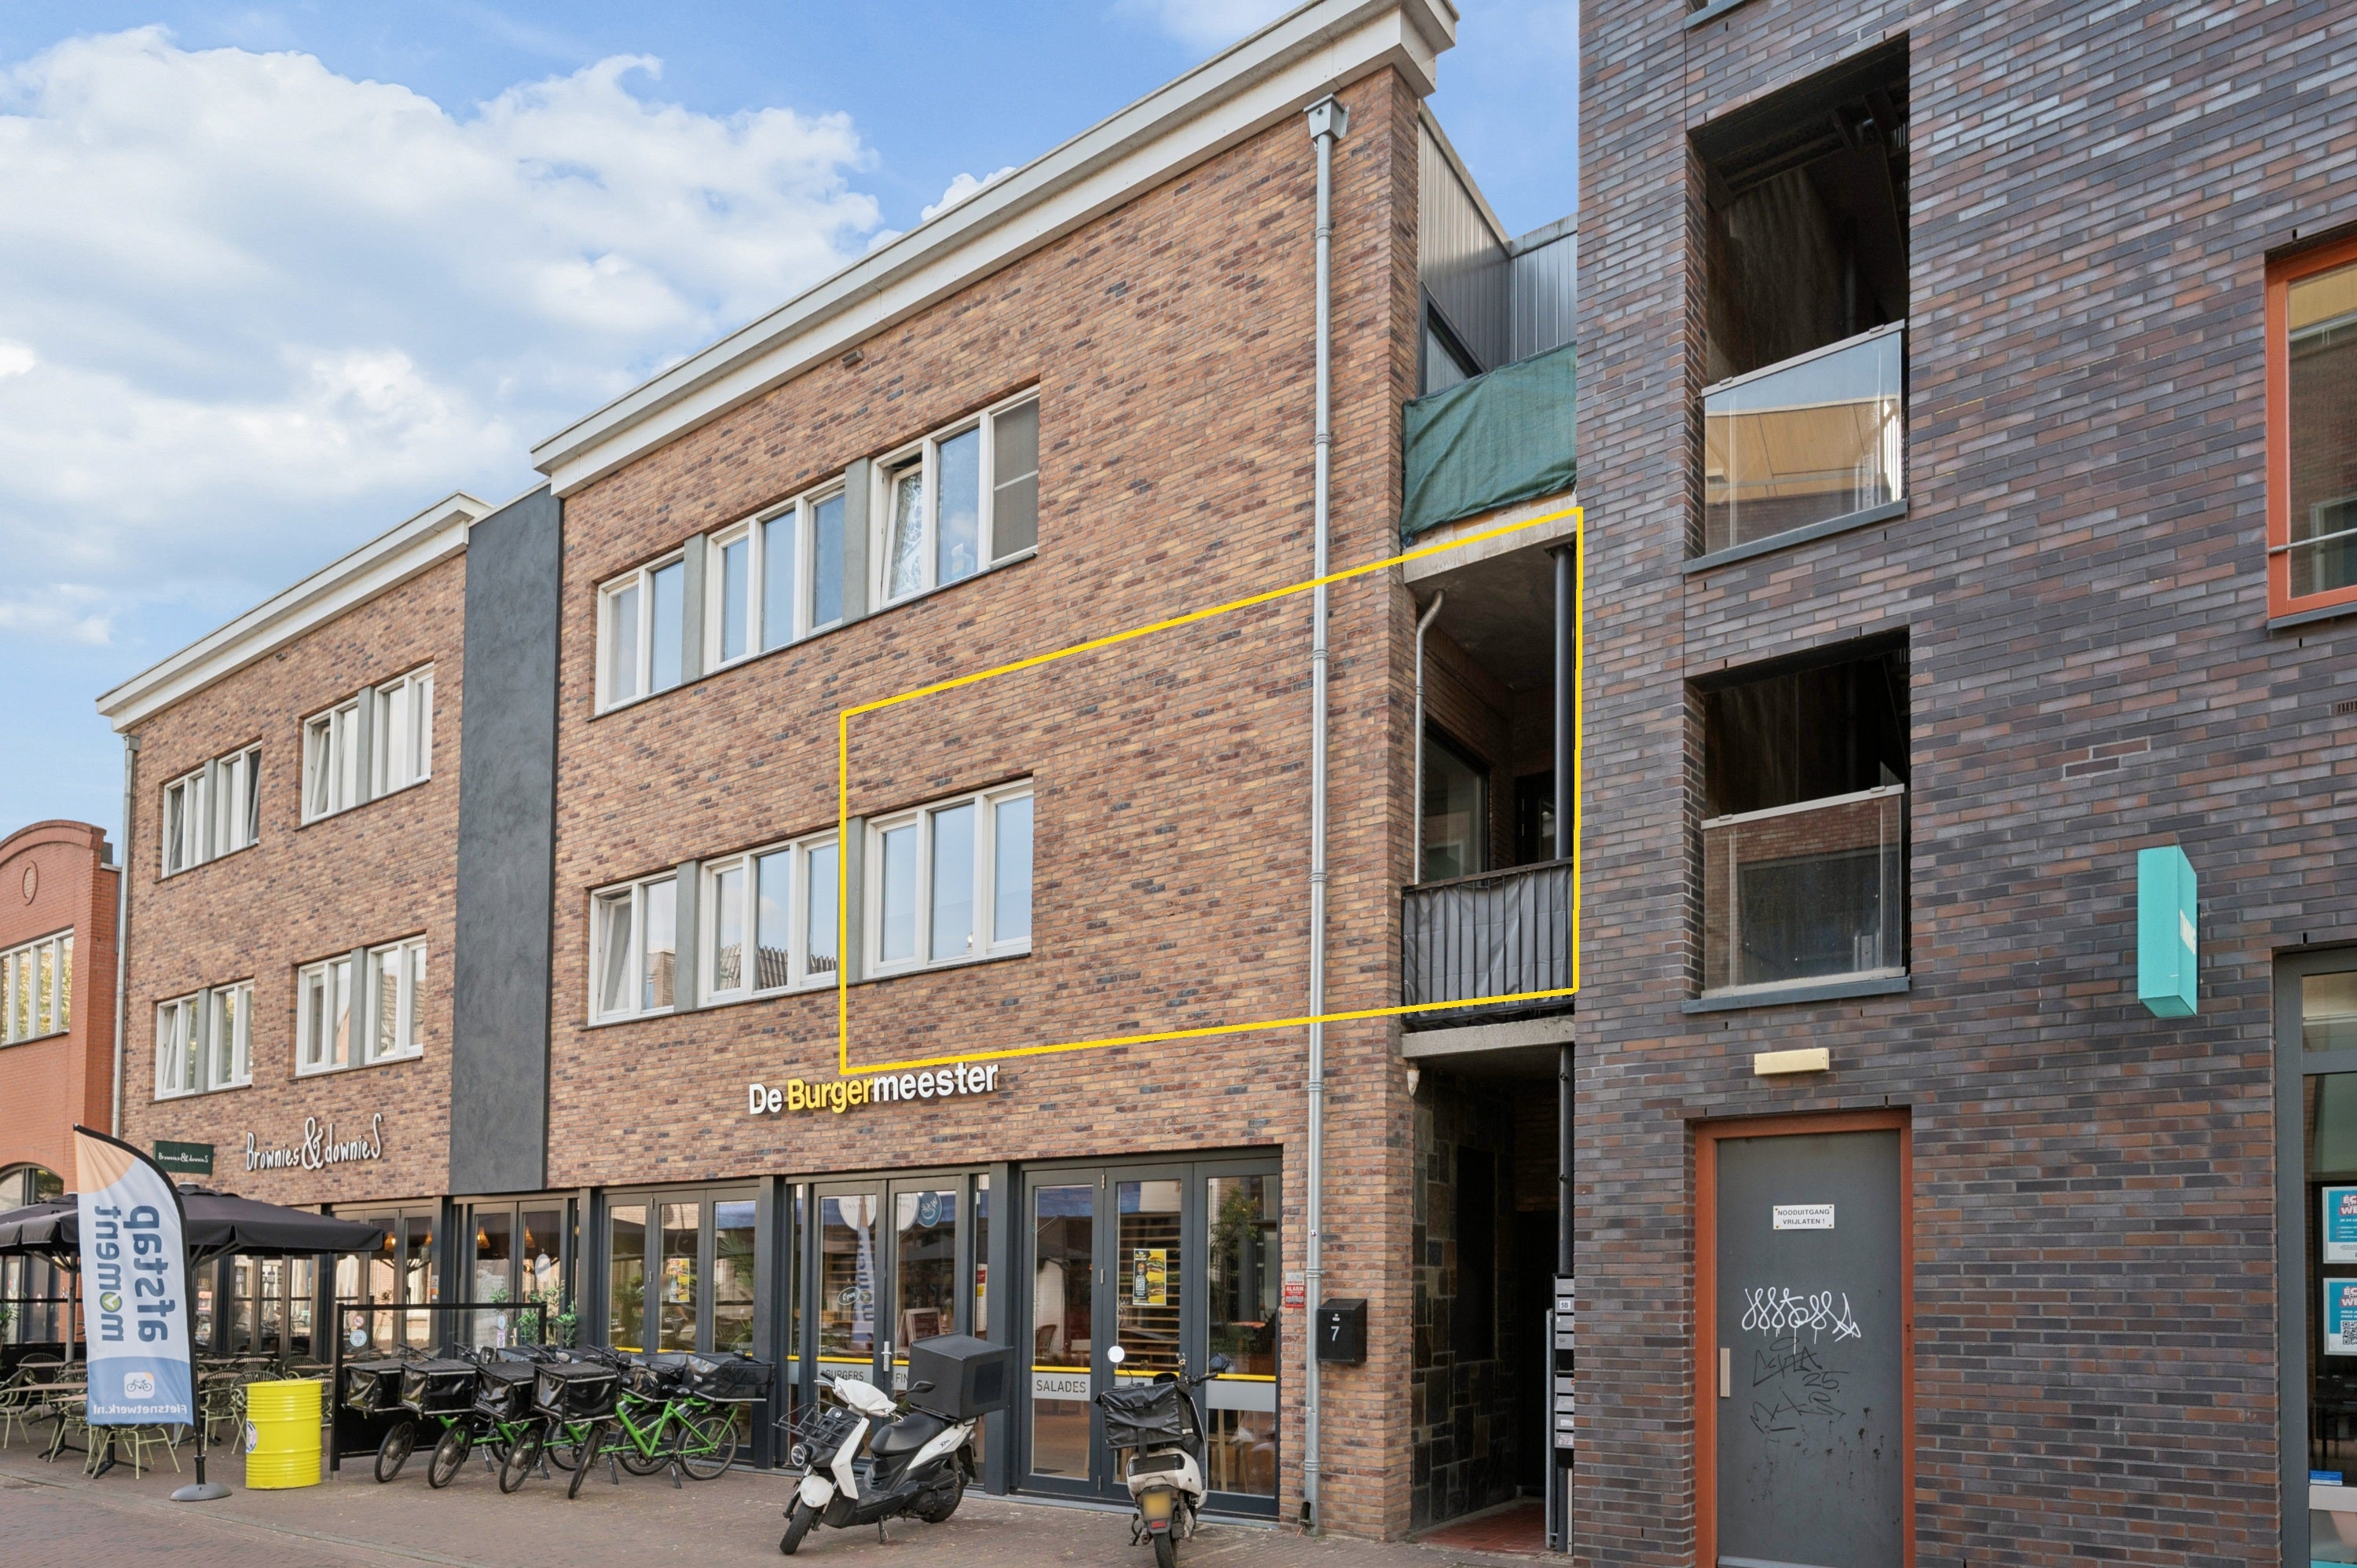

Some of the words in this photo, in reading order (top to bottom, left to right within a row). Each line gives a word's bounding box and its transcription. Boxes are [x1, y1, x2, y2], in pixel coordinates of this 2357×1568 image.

[750, 1083, 783, 1114] De
[787, 1062, 999, 1114] Burgermeester
[247, 1131, 299, 1171] Brownies
[302, 1116, 324, 1171] &
[158, 1152, 180, 1161] Brownies
[1331, 1325, 1340, 1342] 7
[1036, 1379, 1087, 1394] SALADES
